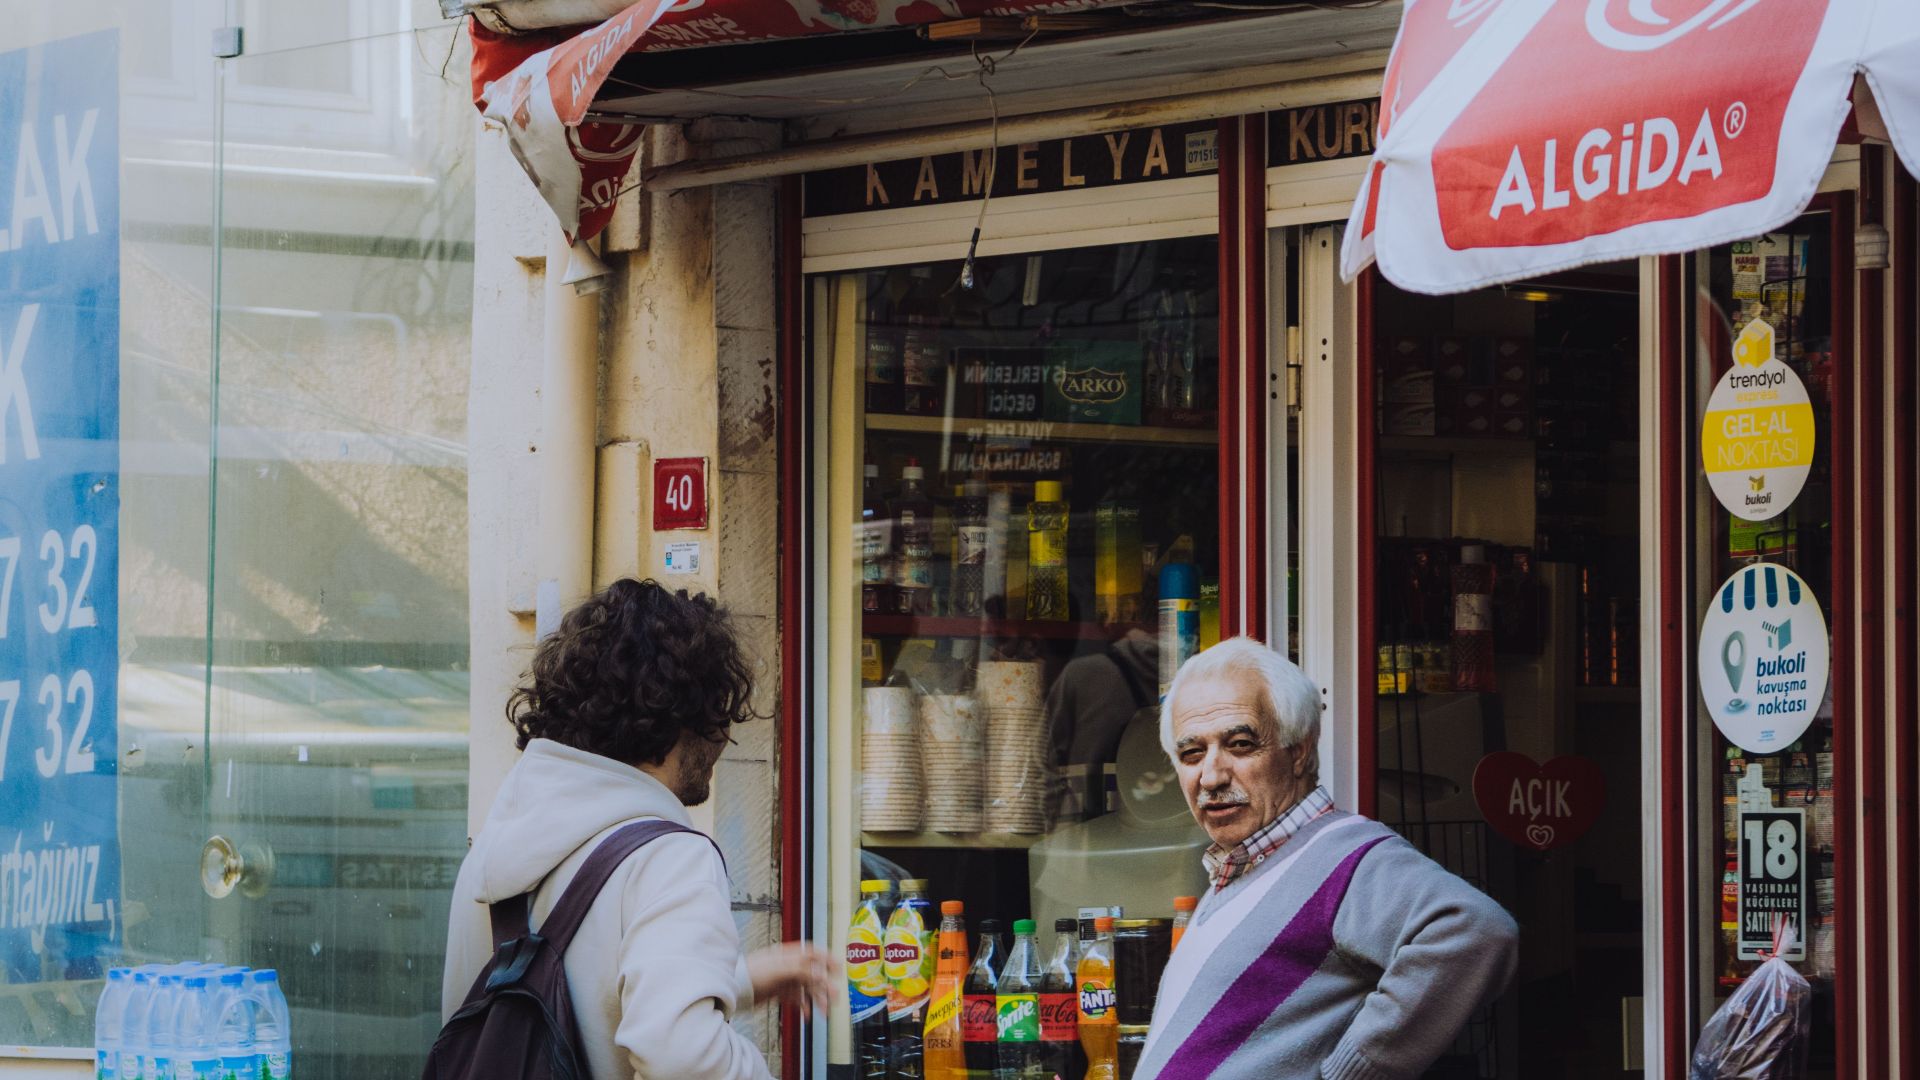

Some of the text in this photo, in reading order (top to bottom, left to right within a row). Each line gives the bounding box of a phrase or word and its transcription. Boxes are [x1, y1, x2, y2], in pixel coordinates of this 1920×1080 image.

[866, 127, 1169, 206] KAMELYA
[0, 107, 100, 253] AK
[1067, 378, 1122, 393] ARKO
[1730, 368, 1786, 392] trendyol
[1723, 410, 1793, 439] GEL-AL
[1717, 438, 1800, 467] NOKTASI
[665, 474, 698, 511] 40
[1745, 492, 1772, 505] bukoli
[1756, 651, 1806, 677] bukoli
[1757, 680, 1807, 697] kavuşma
[1758, 696, 1807, 715] noktası
[1508, 777, 1572, 821] AÇIK
[1744, 819, 1799, 880] 18
[1745, 883, 1798, 894] YAŞINDAN
[1745, 895, 1798, 909] KÜÇÜKLERE
[847, 947, 876, 960] ipton
[997, 1000, 1035, 1038] Sprite
